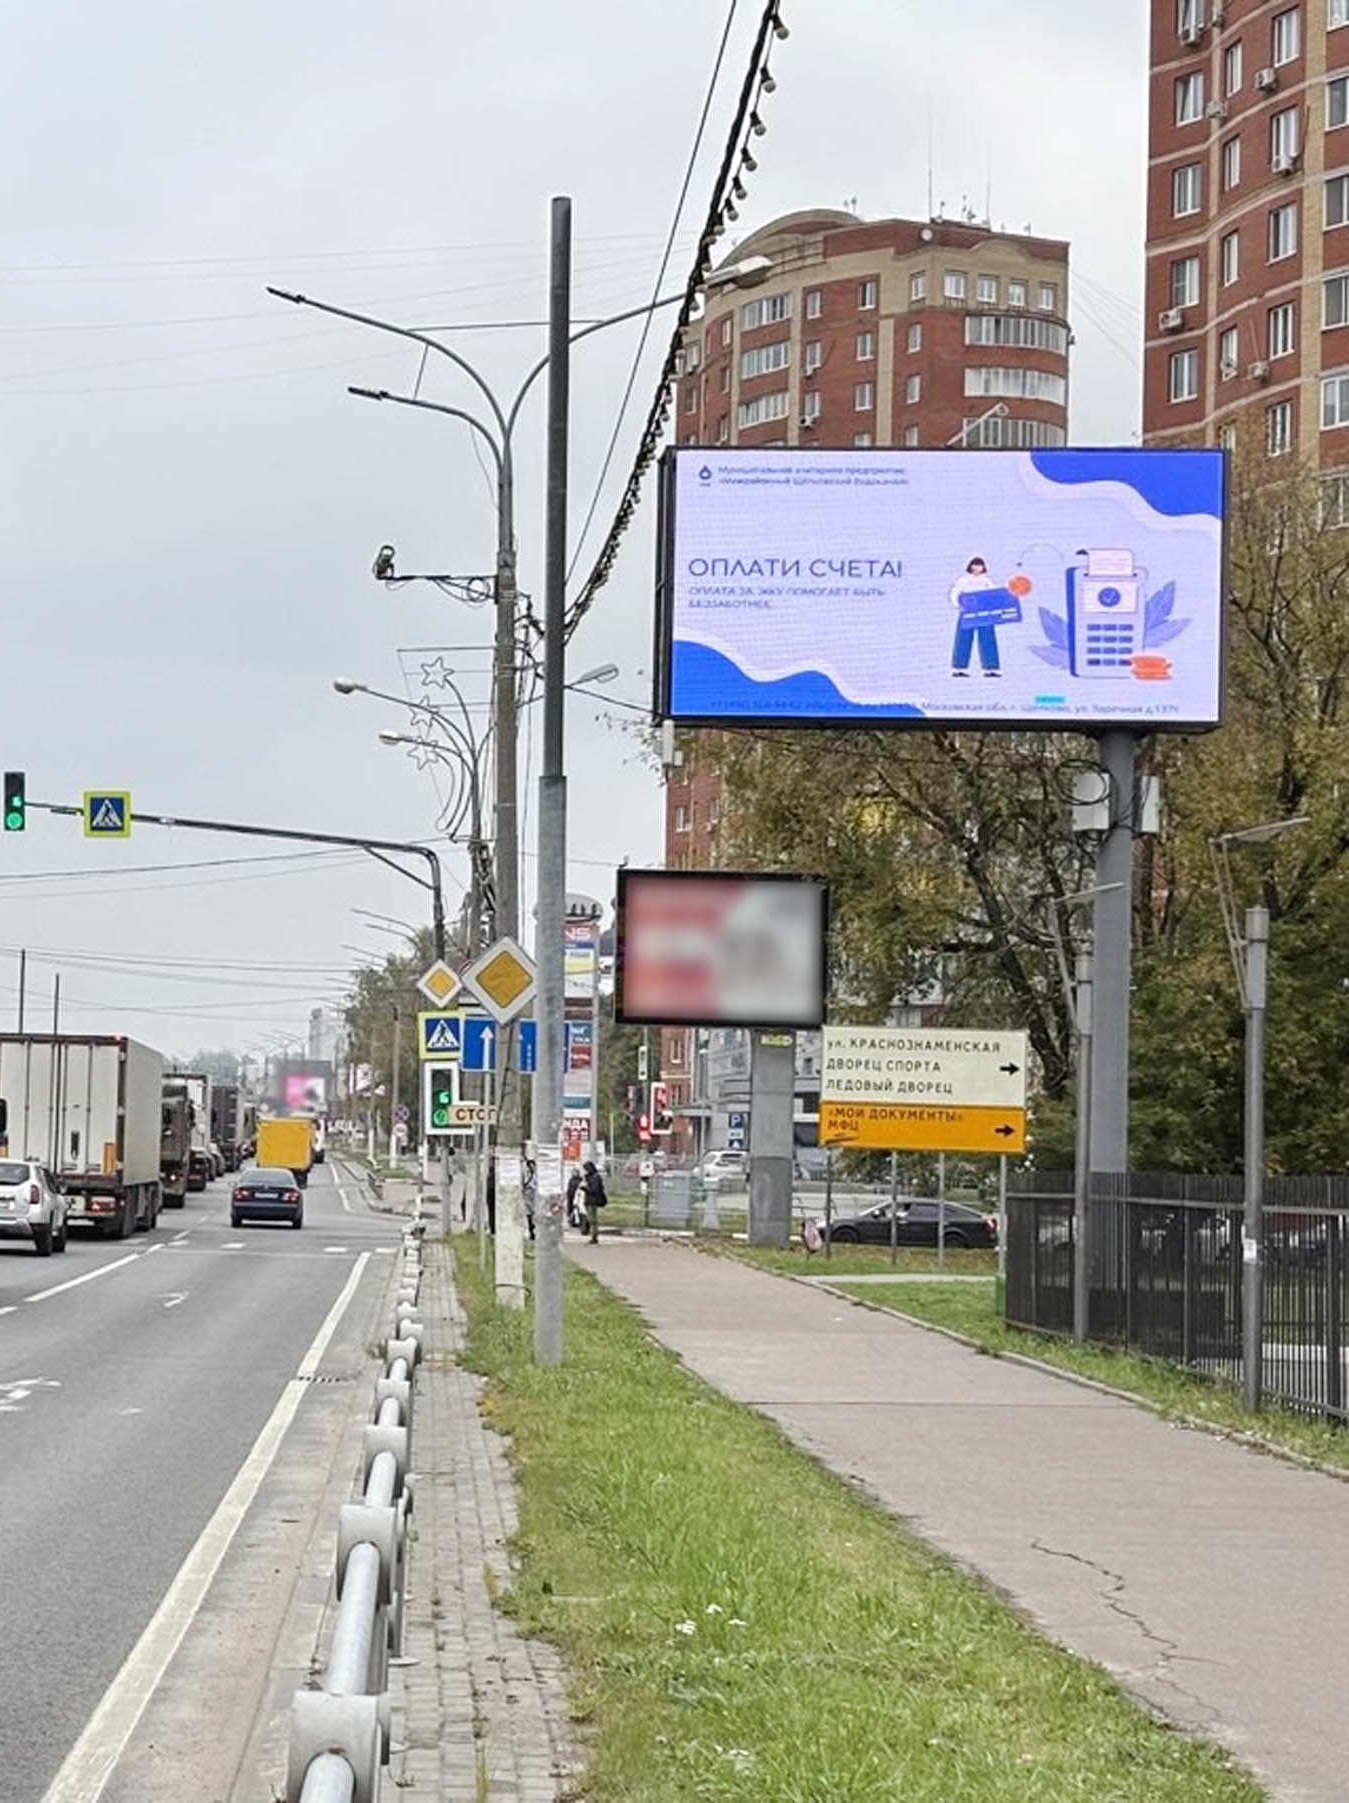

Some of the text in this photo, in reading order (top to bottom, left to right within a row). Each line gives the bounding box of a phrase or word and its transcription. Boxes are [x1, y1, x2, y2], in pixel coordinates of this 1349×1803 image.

[688, 558, 903, 578] ОПЛАТИ СЧЕТА!
[688, 586, 736, 596] ОПЛАТА
[739, 586, 754, 596] ЗА
[785, 587, 850, 597] ПОМОГАЕТ
[827, 1039, 1001, 1053] ул. КРАСНОЗНАМЕНСКАЯ
[826, 1058, 941, 1073] ДВОРЕЦ СПОРТА
[825, 1077, 953, 1095] ЛЕДОВЫЙ ДВОРЕЦ
[827, 1119, 860, 1131] МФЦ
